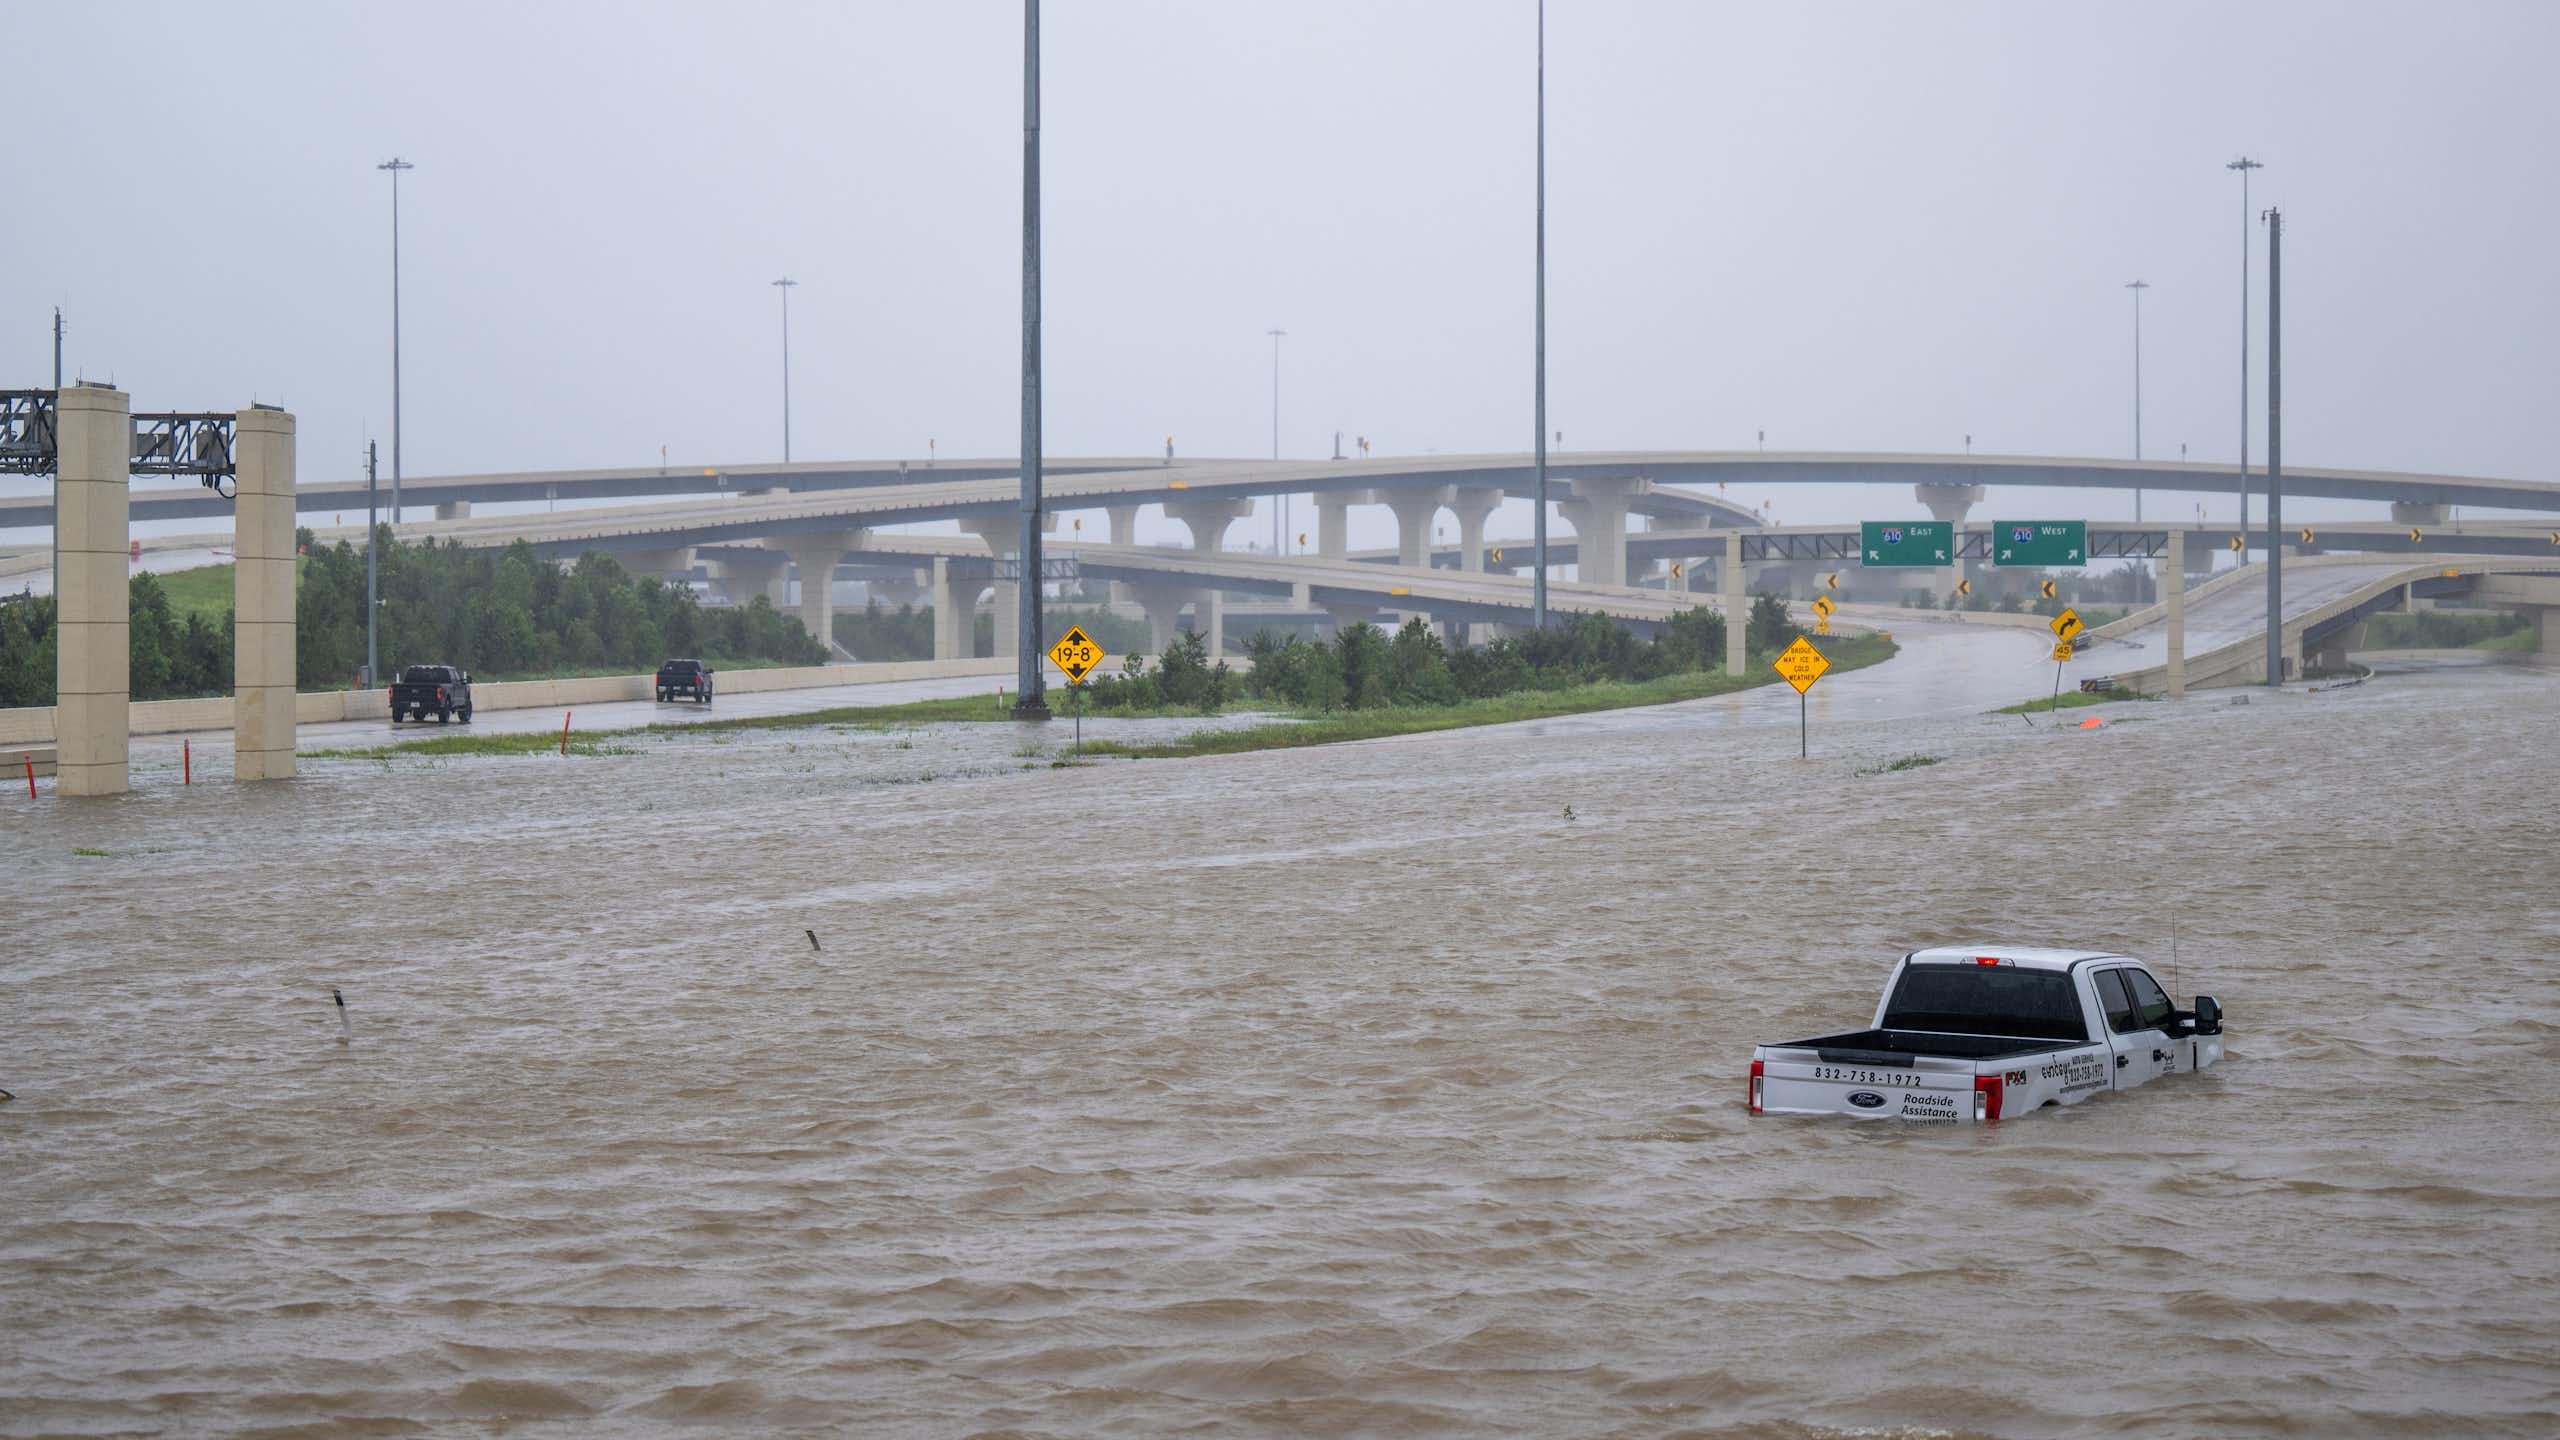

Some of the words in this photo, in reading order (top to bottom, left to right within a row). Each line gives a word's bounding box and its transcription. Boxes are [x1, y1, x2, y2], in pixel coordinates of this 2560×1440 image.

[1910, 527, 1933, 536] EAST
[2041, 526, 2067, 535] WEST
[1884, 531, 1901, 541] 610
[2014, 531, 2032, 541] 610
[2057, 646, 2070, 655] 45
[1815, 1067, 1921, 1087] 832-758-1972
[1855, 1093, 1878, 1104] Ford
[1903, 1093, 1954, 1107] Roadside
[1901, 1104, 1958, 1119] Assistance
